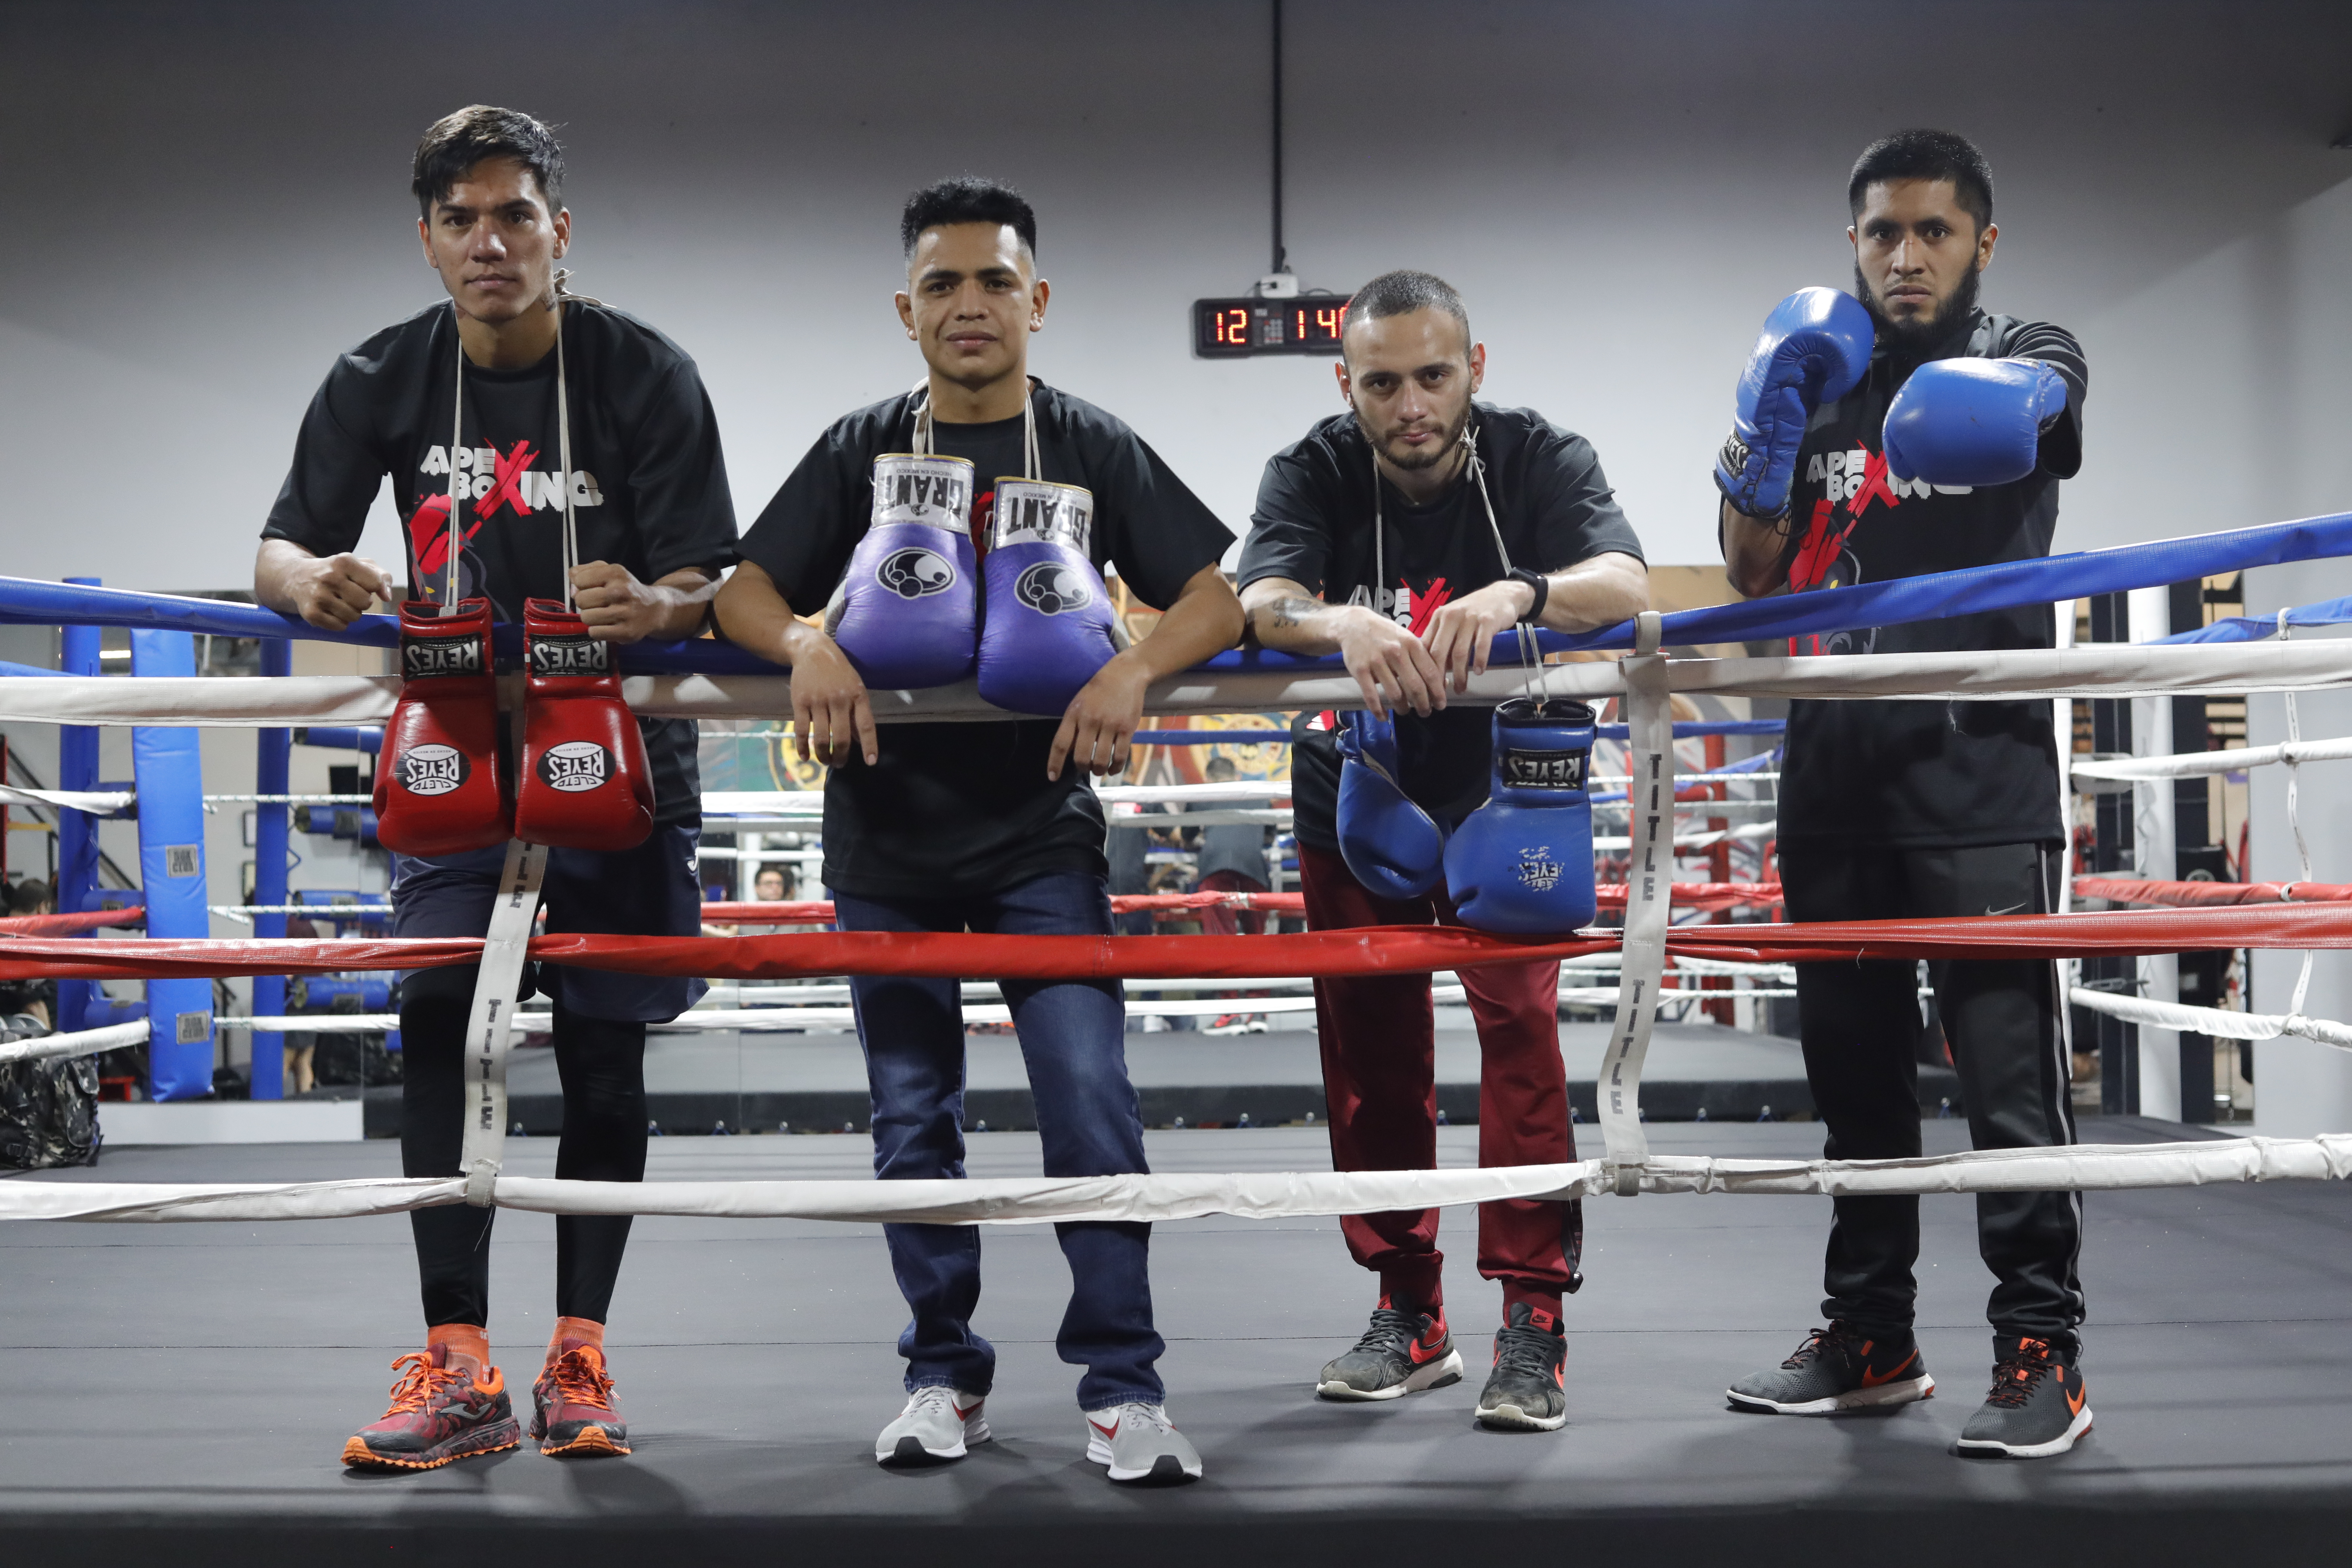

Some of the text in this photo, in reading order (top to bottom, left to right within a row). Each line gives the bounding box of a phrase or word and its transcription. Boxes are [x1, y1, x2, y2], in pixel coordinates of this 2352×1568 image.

[1216, 309, 1247, 343] 12
[880, 475, 964, 521] GRANT
[406, 640, 479, 672] REYES
[533, 640, 608, 671] REYES
[406, 752, 459, 783] REYES
[548, 749, 605, 780] REYES
[1508, 755, 1580, 781] REYES
[413, 780, 452, 790] CLETO
[557, 776, 597, 787] CLETO
[1642, 753, 1662, 901] TITLE
[1610, 979, 1646, 1115] TITLE
[480, 998, 502, 1130] TITLE
